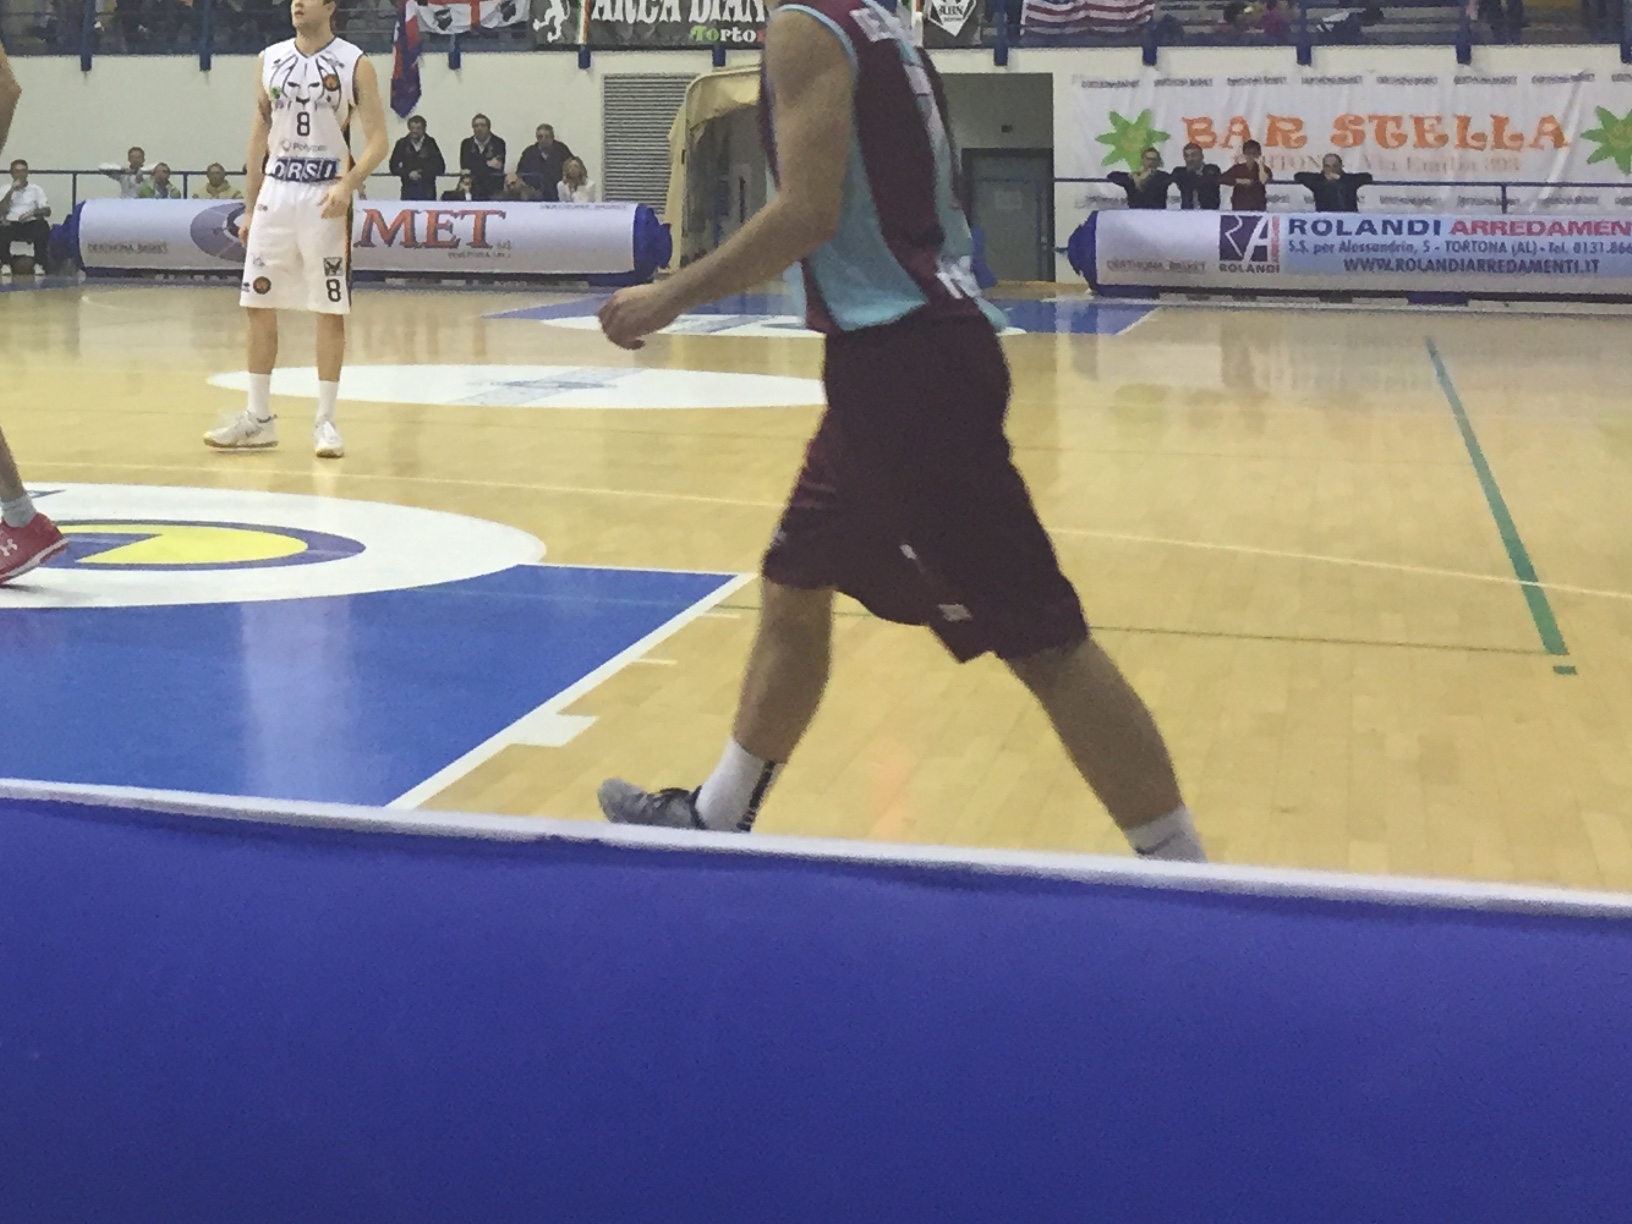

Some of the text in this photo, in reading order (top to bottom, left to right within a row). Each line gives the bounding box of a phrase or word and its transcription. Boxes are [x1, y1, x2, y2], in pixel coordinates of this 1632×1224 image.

[296, 111, 310, 137] 8
[1181, 112, 1570, 151] BAR STELLA
[353, 208, 506, 248] MET
[1288, 218, 1632, 237] ROLANDI ARREDAMEN
[1445, 240, 1508, 254] TORTONA
[1219, 264, 1280, 274] ROLANDI
[326, 278, 341, 303] 8
